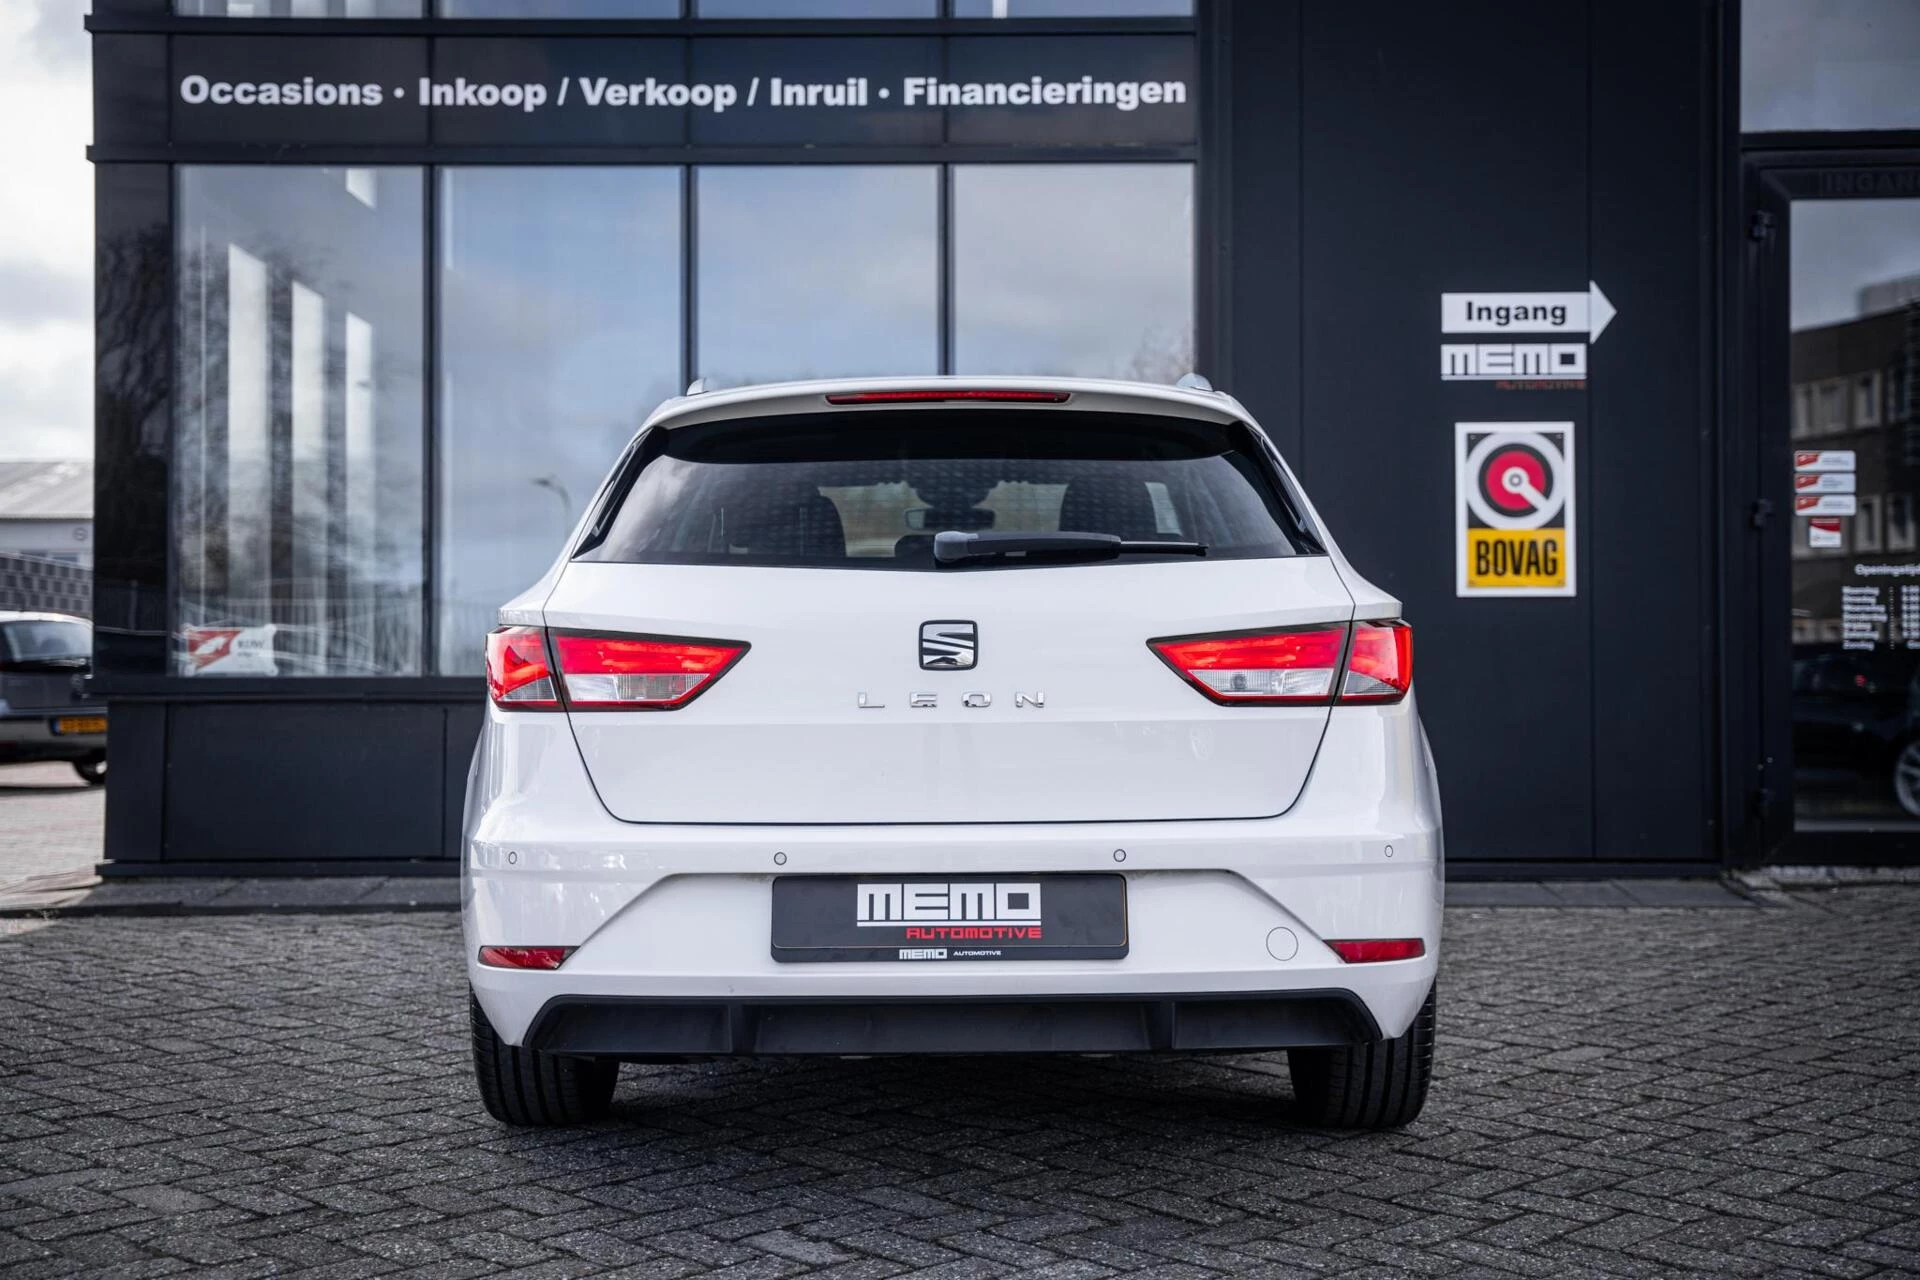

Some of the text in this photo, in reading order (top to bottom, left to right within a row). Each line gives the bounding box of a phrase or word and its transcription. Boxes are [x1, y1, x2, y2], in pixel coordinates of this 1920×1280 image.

[180, 74, 383, 106] Occasions
[419, 77, 547, 113] Inkoop
[578, 77, 738, 113] Verkoop
[770, 77, 868, 107] Inruil
[903, 75, 1187, 112] Financieringen
[1826, 171, 1920, 192] INGAN
[1465, 301, 1567, 326] Ingang
[1441, 343, 1587, 376] MEMO
[1475, 539, 1558, 577] BOVAG
[857, 691, 1045, 709] LEON
[856, 882, 1042, 921] MEMO
[906, 927, 1042, 940] AUTOMOTIVE
[898, 948, 948, 960] MEMO
